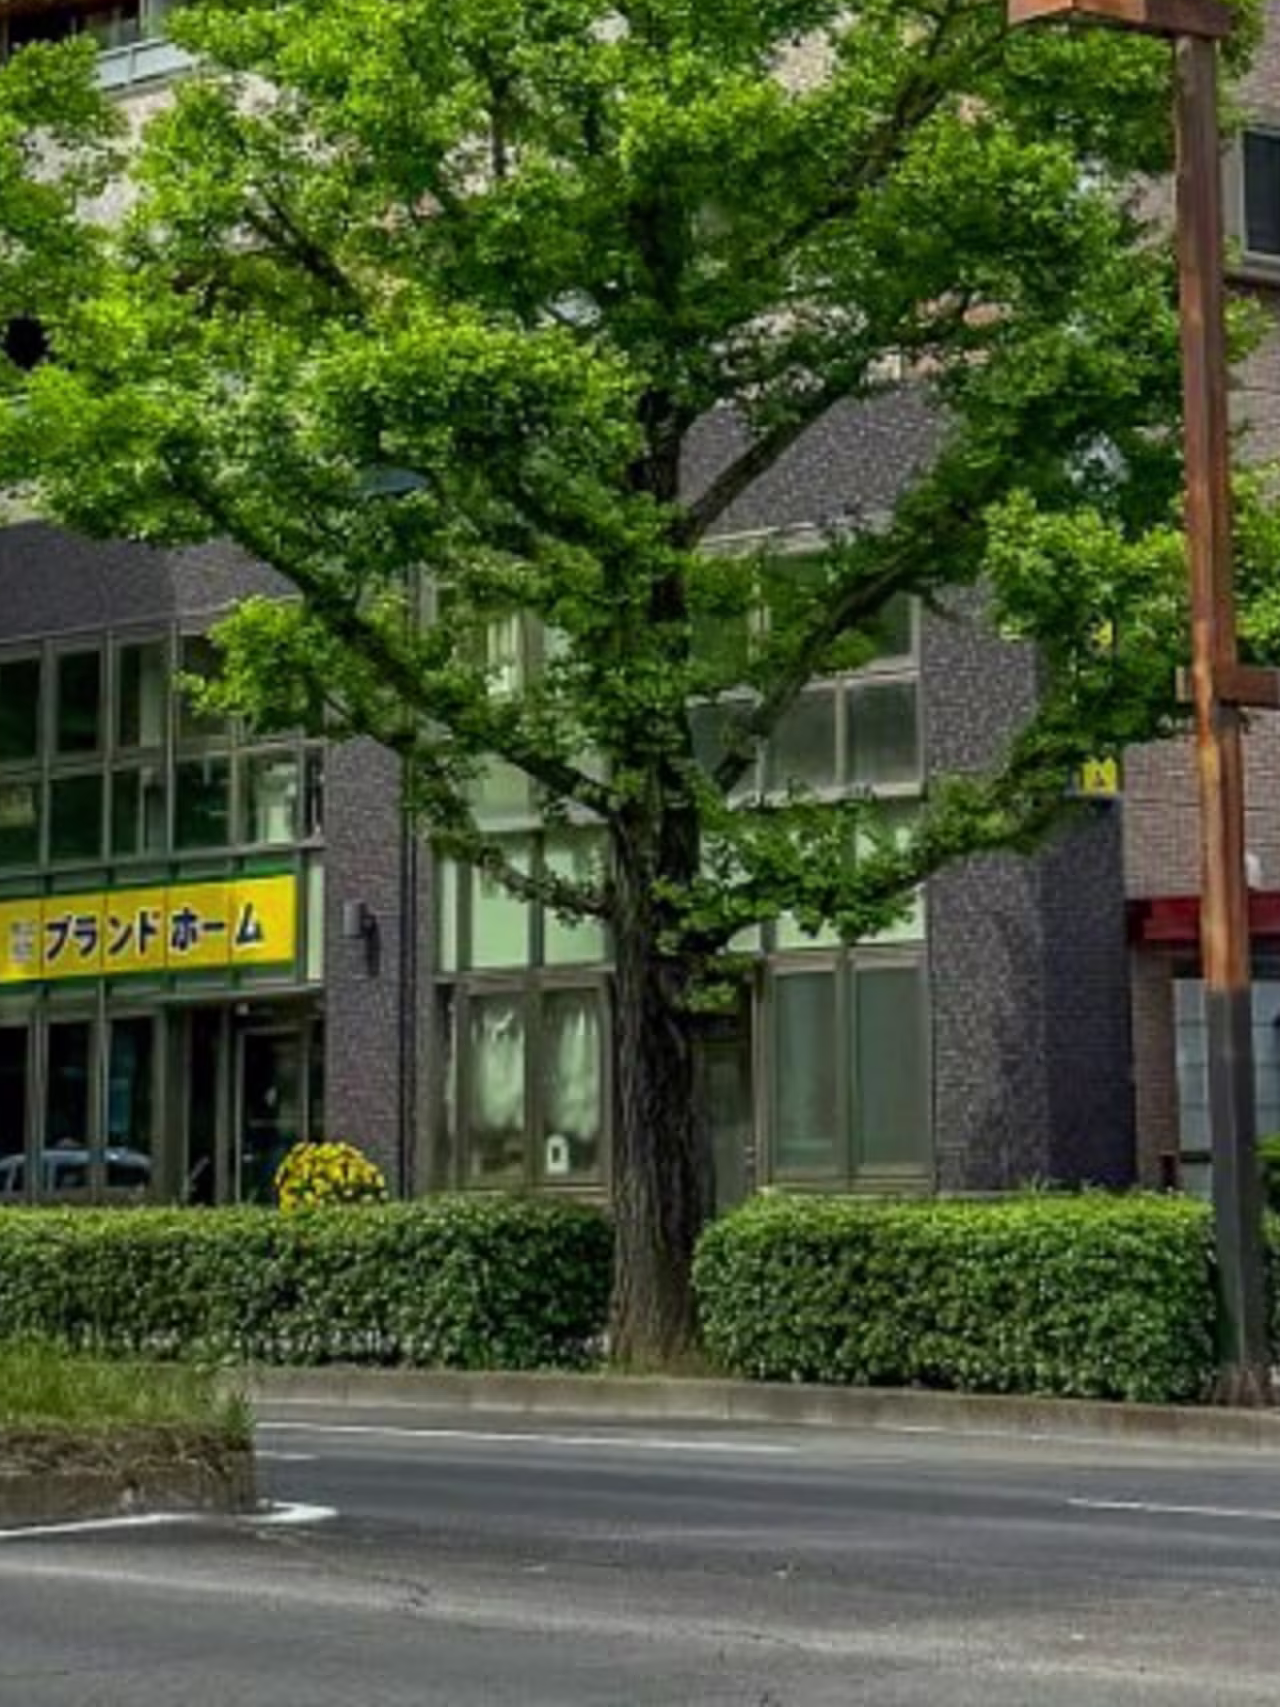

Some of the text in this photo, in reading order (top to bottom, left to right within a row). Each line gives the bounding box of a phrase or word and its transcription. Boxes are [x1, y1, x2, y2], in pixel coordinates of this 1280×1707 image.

[46, 904, 262, 960] ブランドホーム
